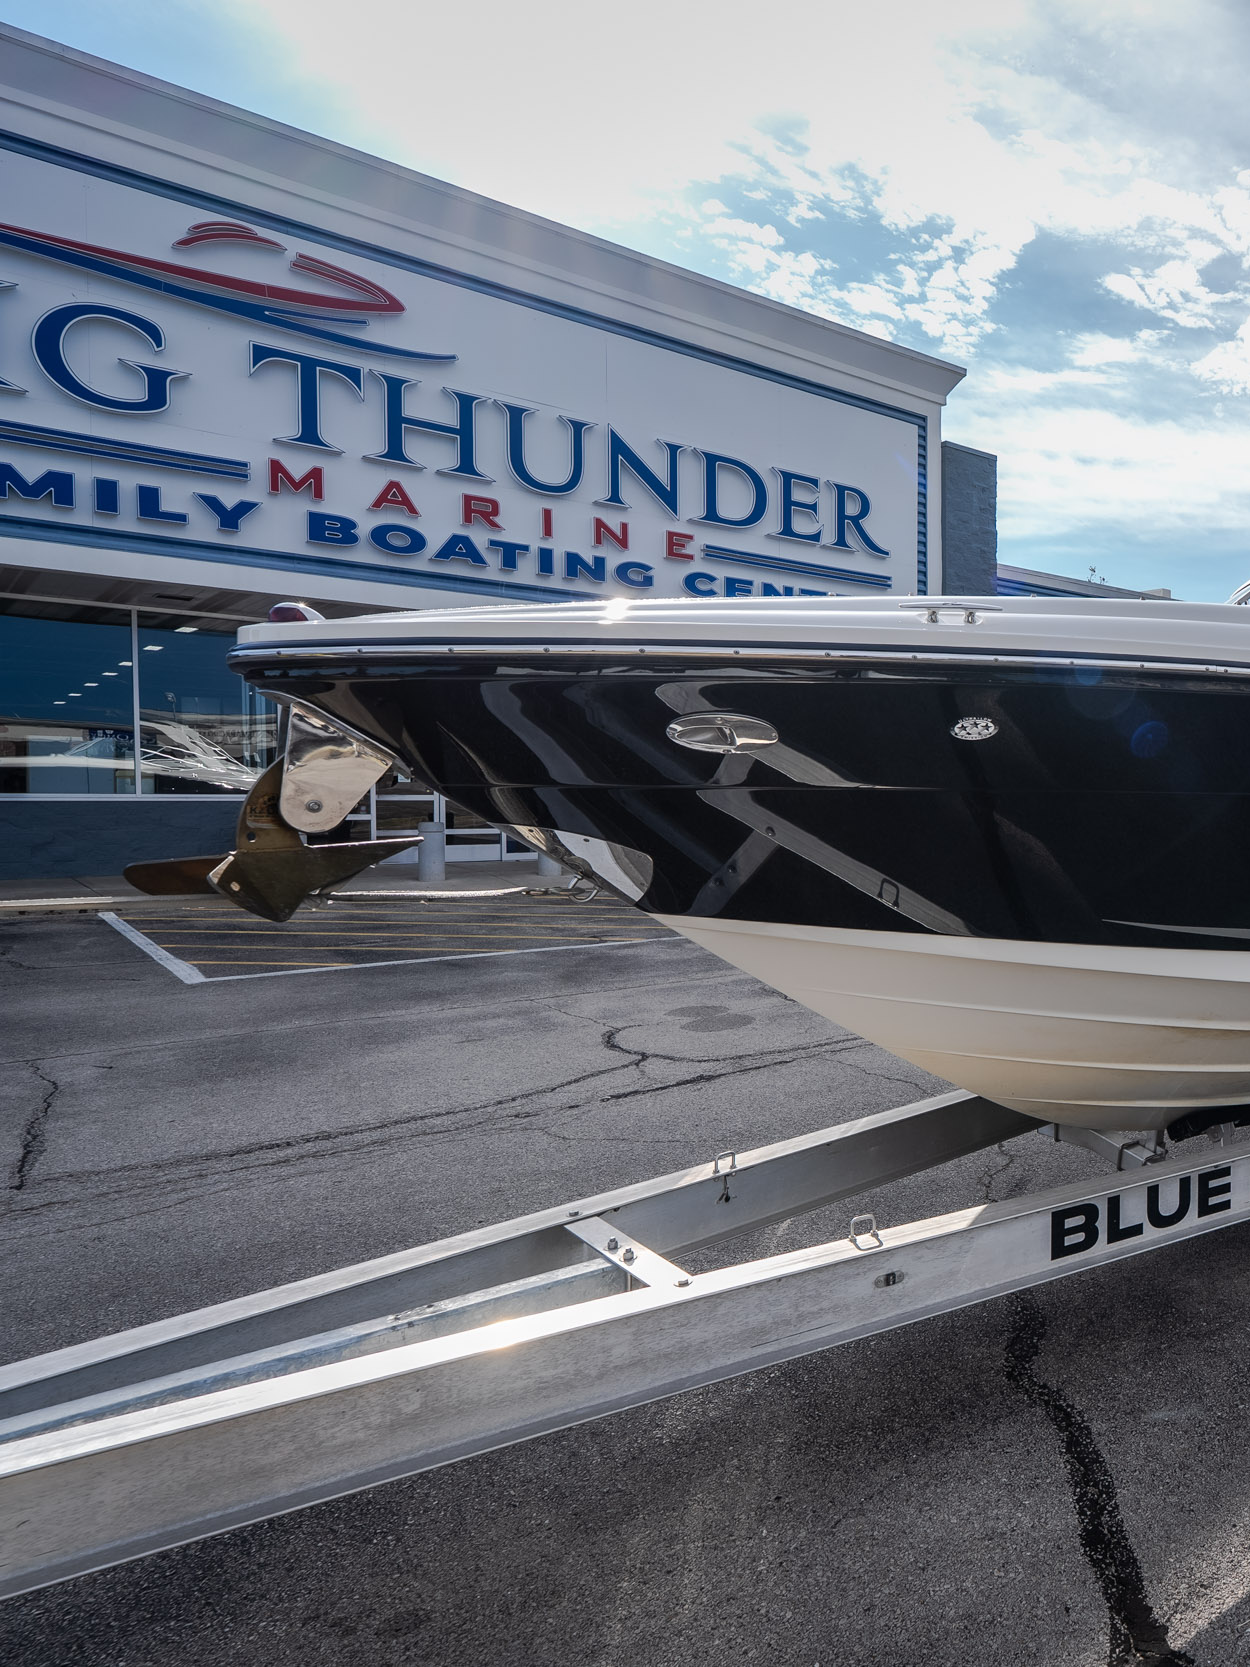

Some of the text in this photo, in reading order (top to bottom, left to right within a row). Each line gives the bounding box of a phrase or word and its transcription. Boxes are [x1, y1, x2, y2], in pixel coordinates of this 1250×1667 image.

[248, 339, 892, 558] THUNDER
[267, 457, 695, 561] MARINE
[306, 509, 655, 590] BOATING
[1051, 1166, 1232, 1261] BLUE
